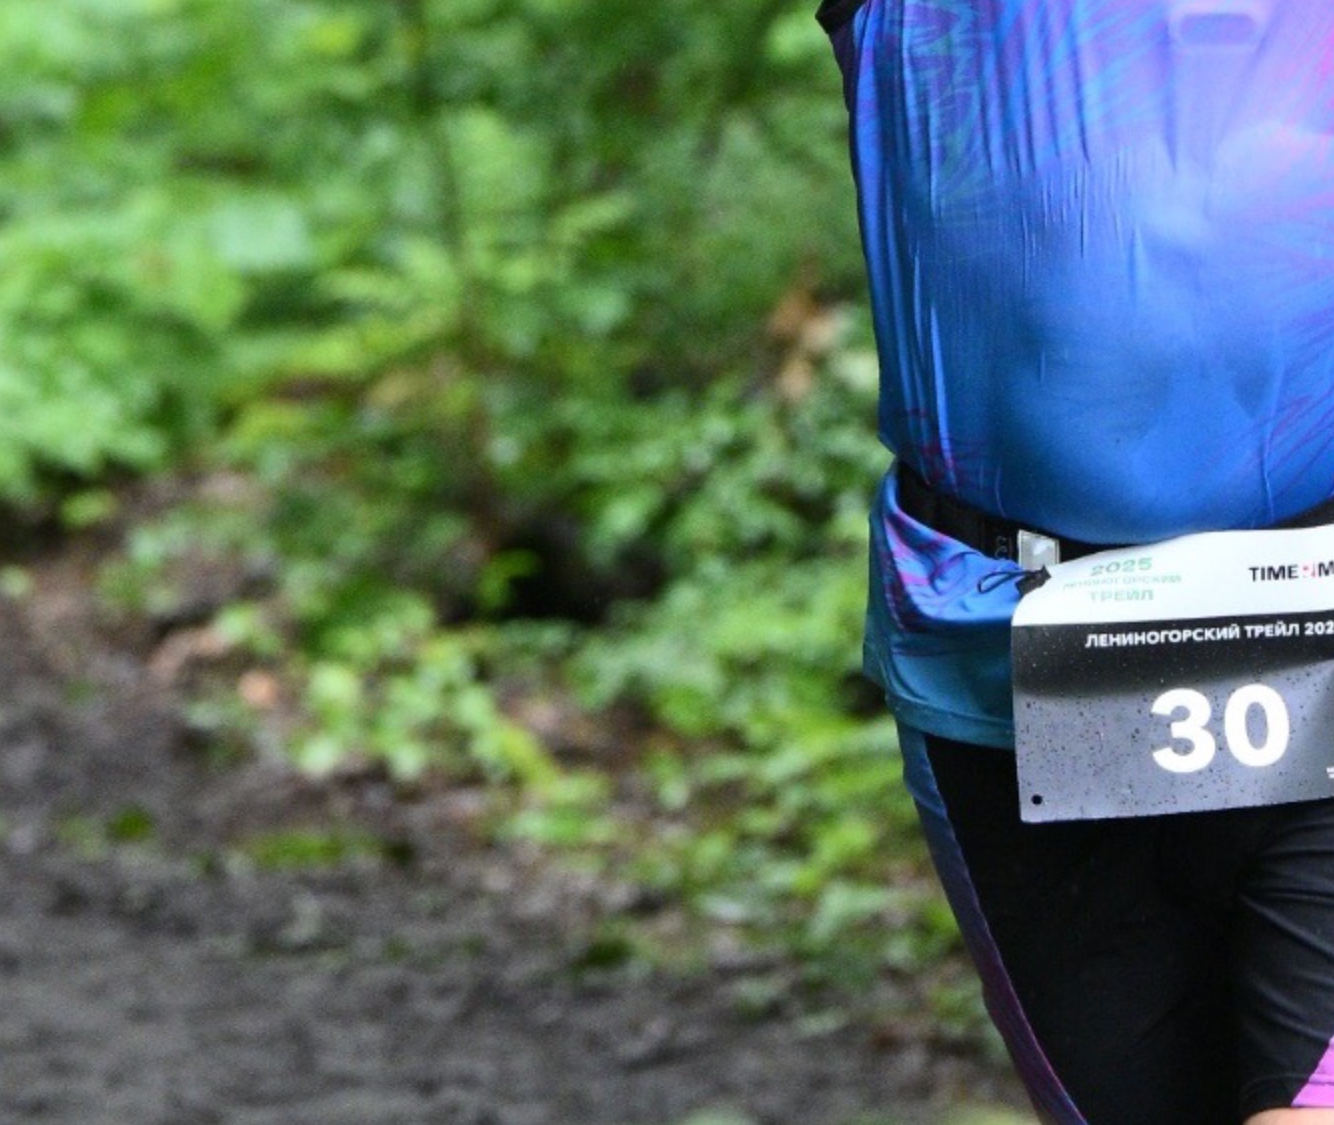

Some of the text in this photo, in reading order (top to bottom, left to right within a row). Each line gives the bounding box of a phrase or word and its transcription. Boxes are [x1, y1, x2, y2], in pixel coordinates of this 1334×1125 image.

[1090, 557, 1152, 576] 2025
[1085, 623, 1241, 648] ЛЕНИНОГОРСКИЙ
[1244, 621, 1300, 639] ТРЕЙЛ
[1151, 684, 1290, 773] 30
